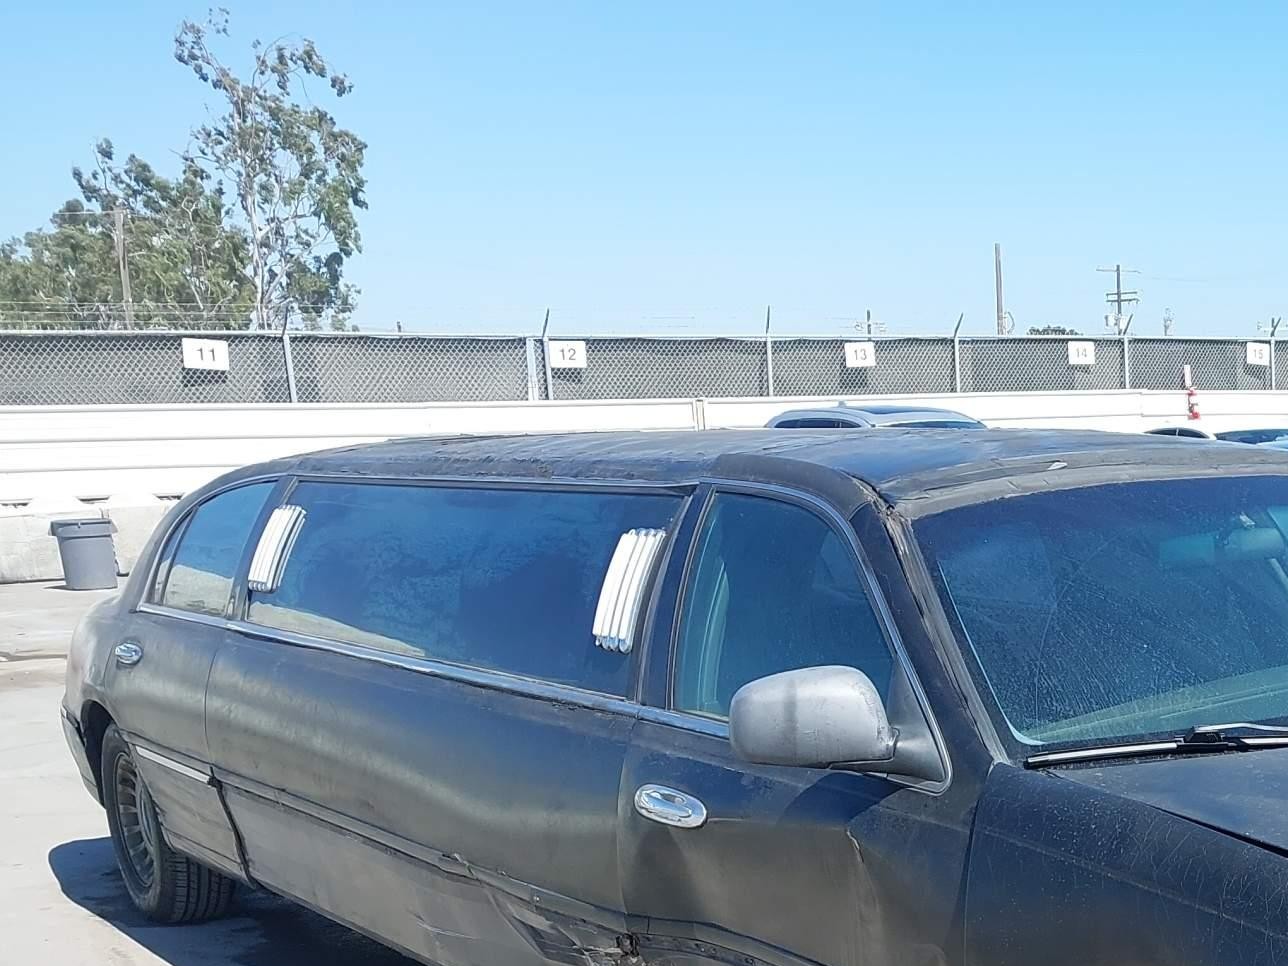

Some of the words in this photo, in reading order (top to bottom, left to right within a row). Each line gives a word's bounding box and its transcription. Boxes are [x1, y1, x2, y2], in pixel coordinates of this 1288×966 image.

[196, 347, 216, 362] 11
[560, 348, 576, 361] 12
[854, 348, 868, 361] 13
[1075, 347, 1088, 358] 14
[1253, 348, 1264, 360] 15
